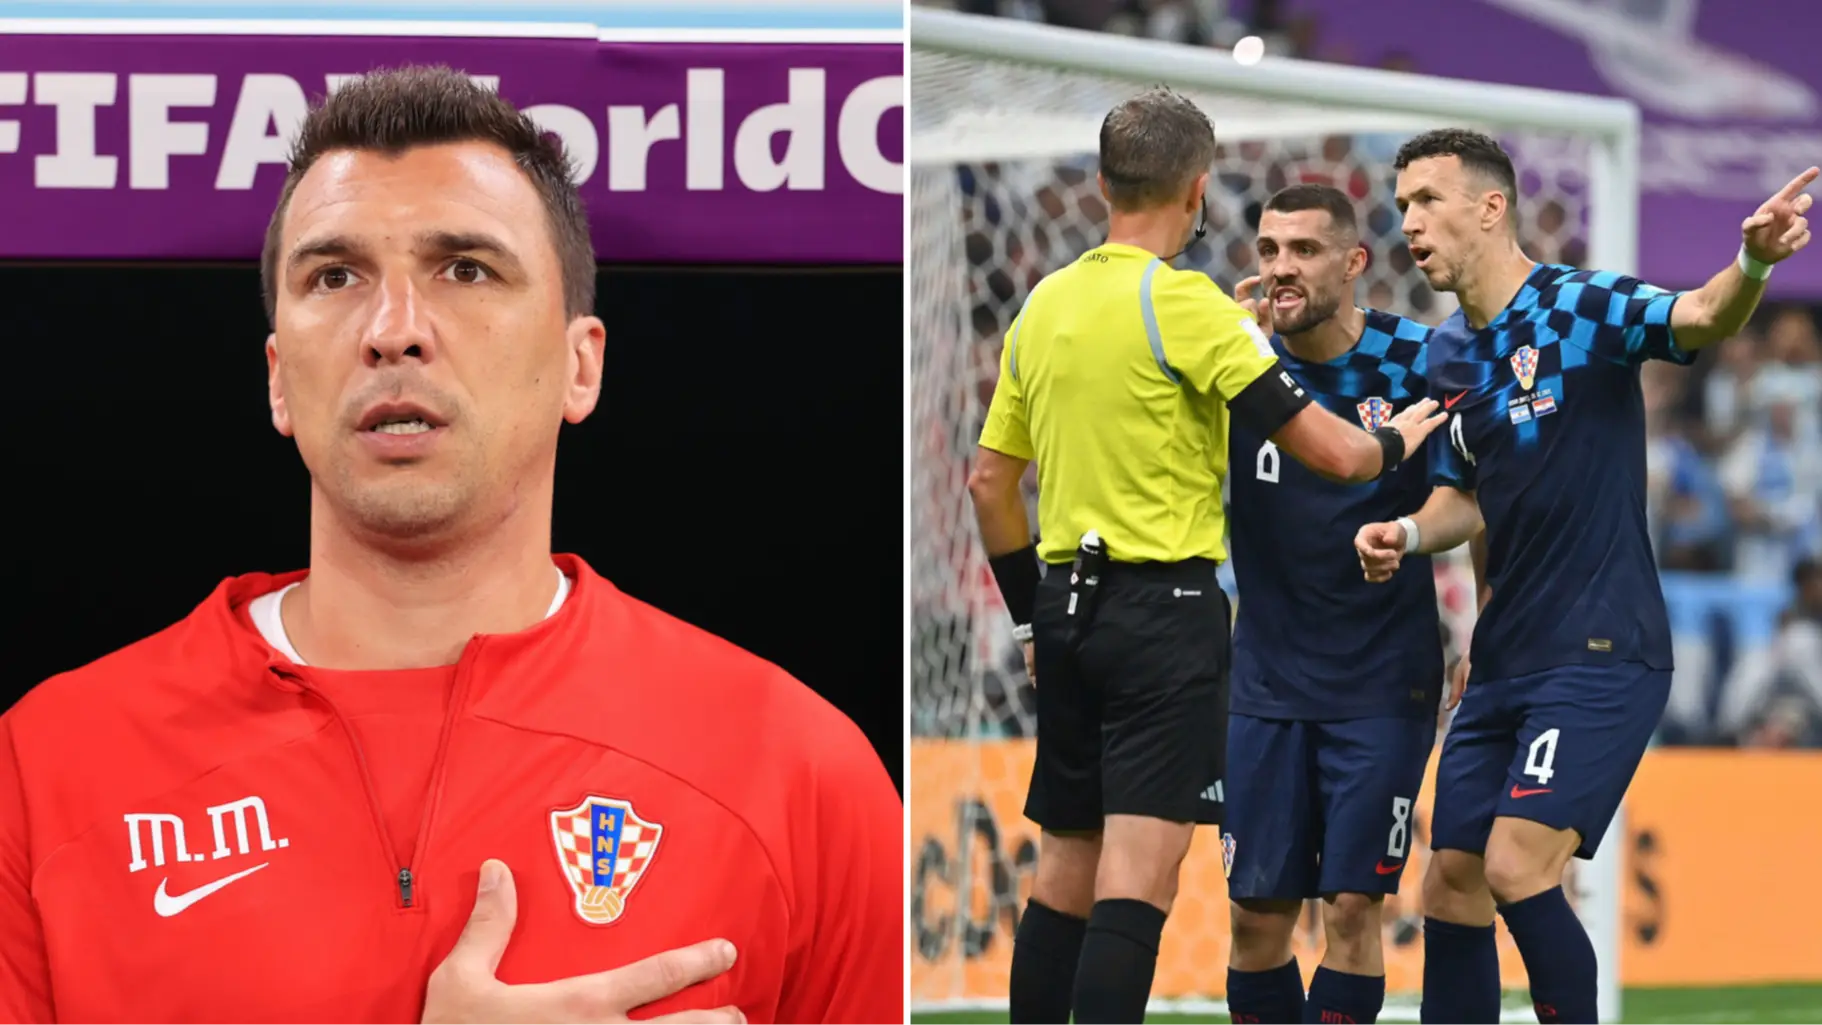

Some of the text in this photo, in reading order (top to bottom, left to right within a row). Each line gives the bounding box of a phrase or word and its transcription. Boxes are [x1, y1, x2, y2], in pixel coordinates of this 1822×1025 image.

[1524, 728, 1560, 784] 4
[597, 812, 615, 876] HNS
[1386, 796, 1411, 858] 8
